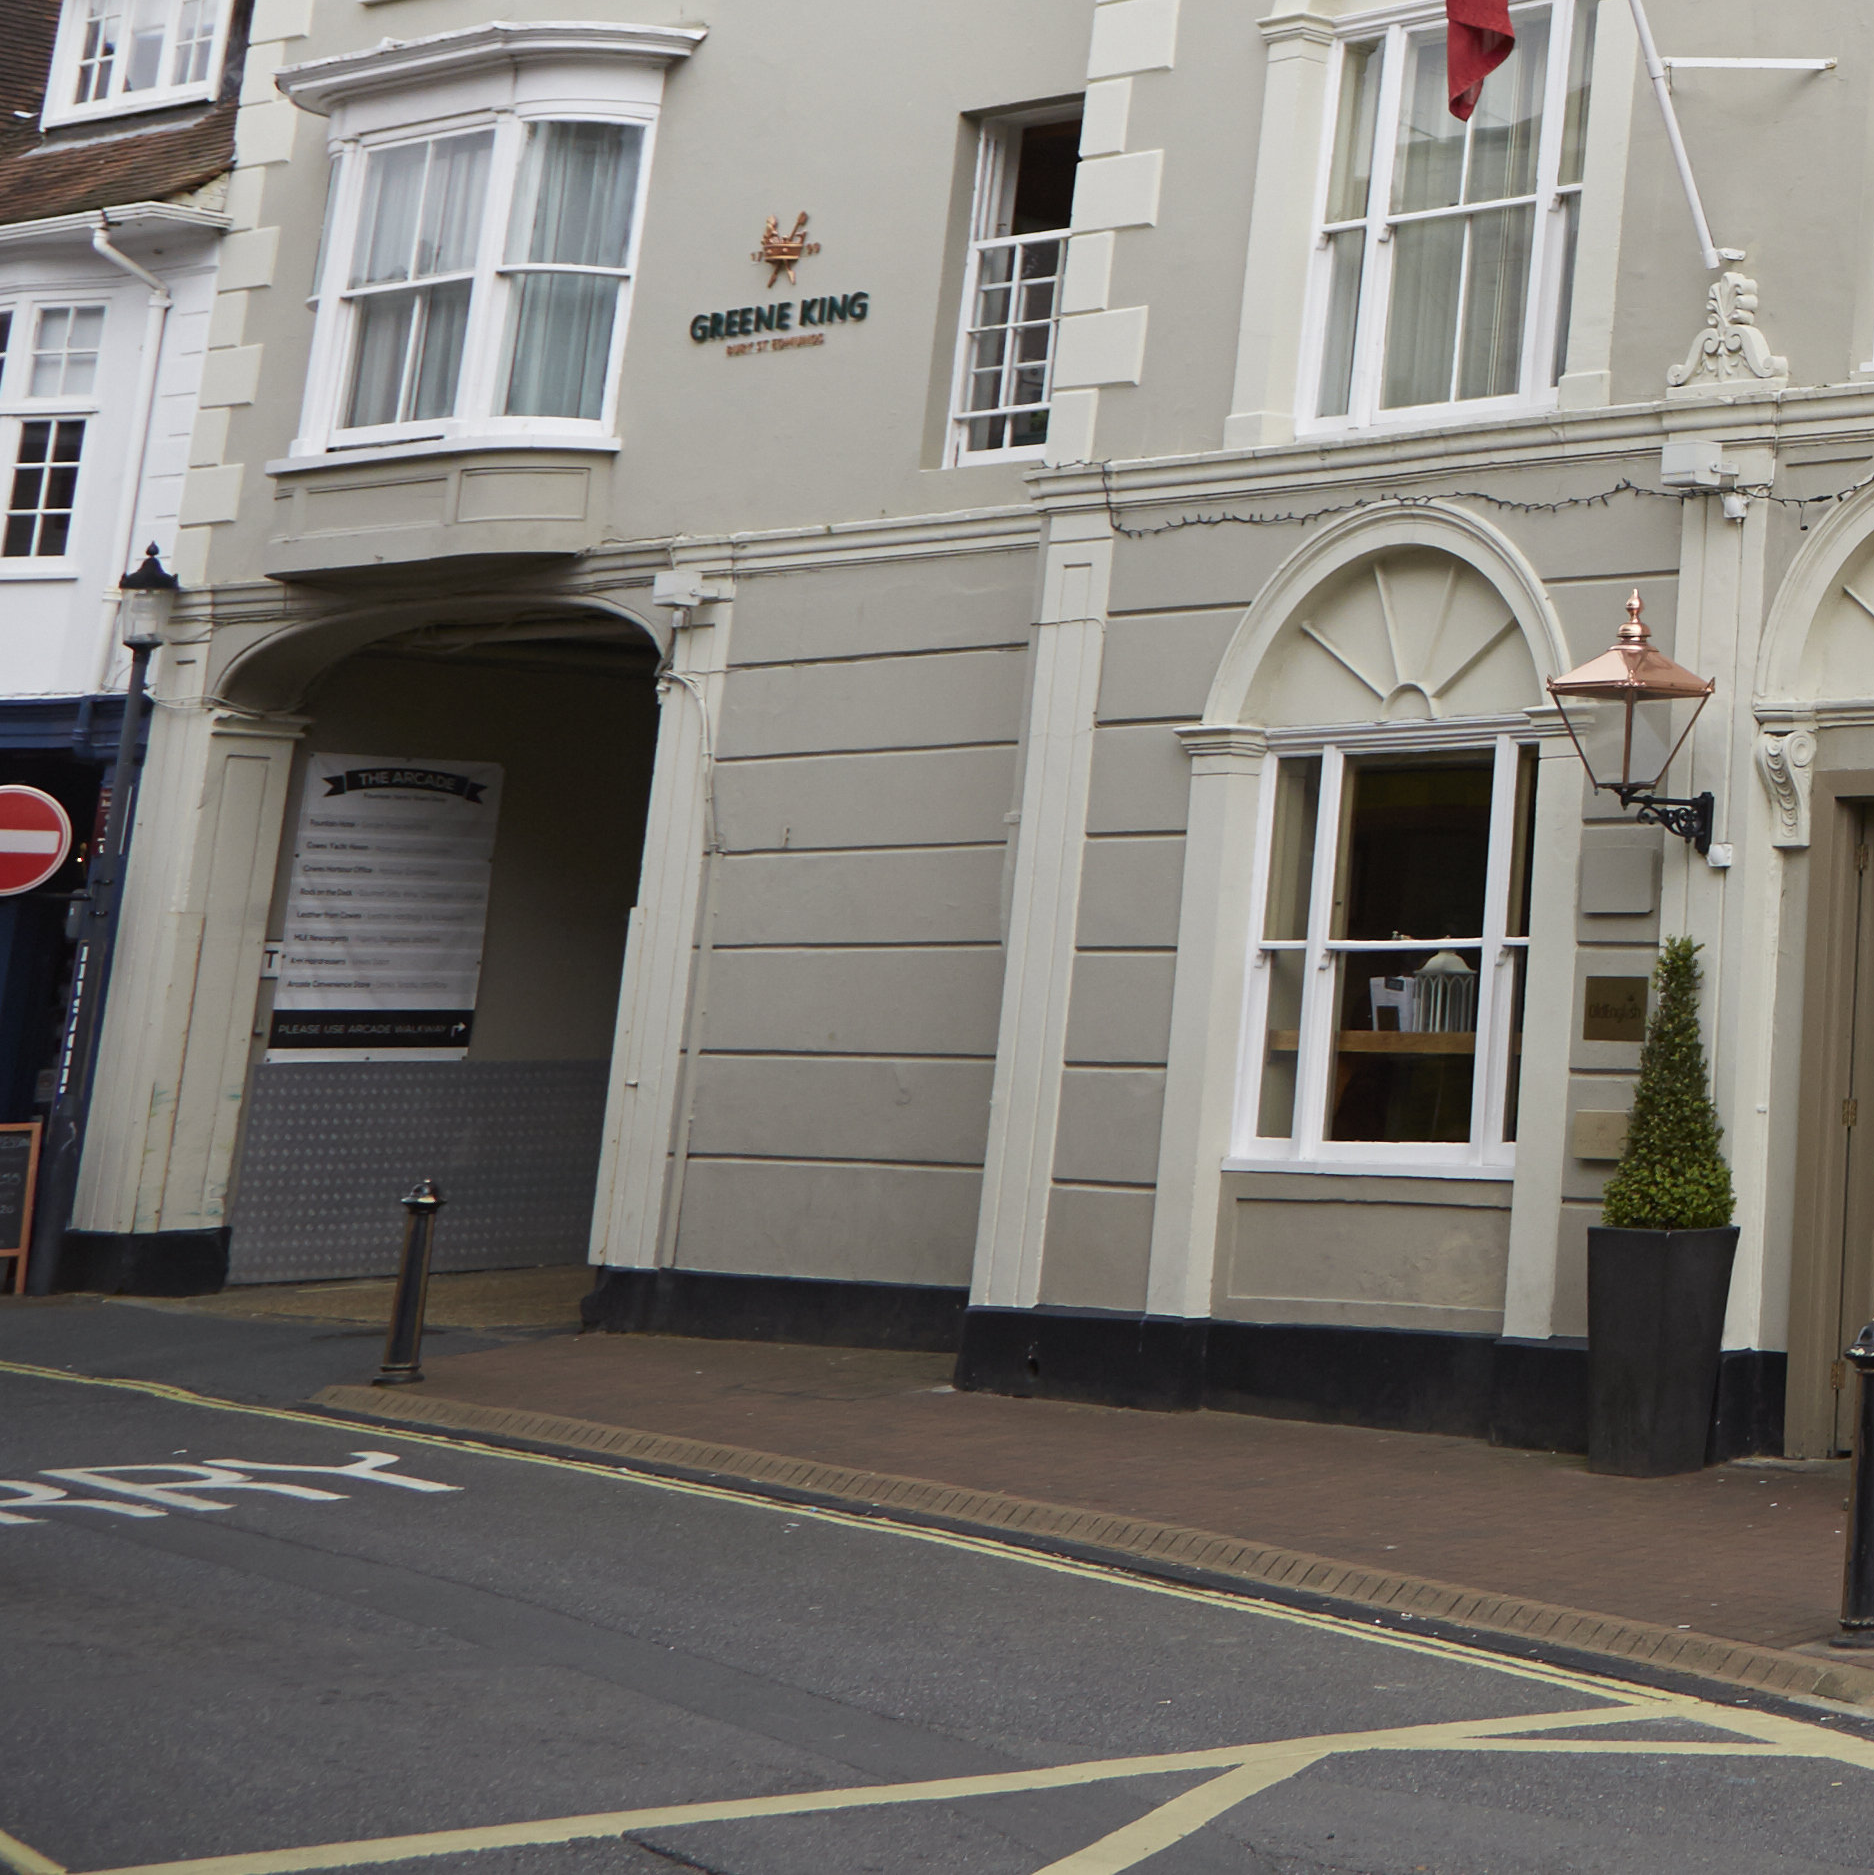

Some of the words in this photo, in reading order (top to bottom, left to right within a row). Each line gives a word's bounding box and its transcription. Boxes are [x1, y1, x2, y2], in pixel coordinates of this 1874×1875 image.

[690, 302, 793, 344] GREENE
[799, 291, 870, 327] KING
[358, 772, 390, 787] THE
[391, 771, 458, 791] ARCADE
[278, 1024, 322, 1035] PLEASE
[324, 1024, 346, 1035] USE
[348, 1024, 391, 1035] ARCADE
